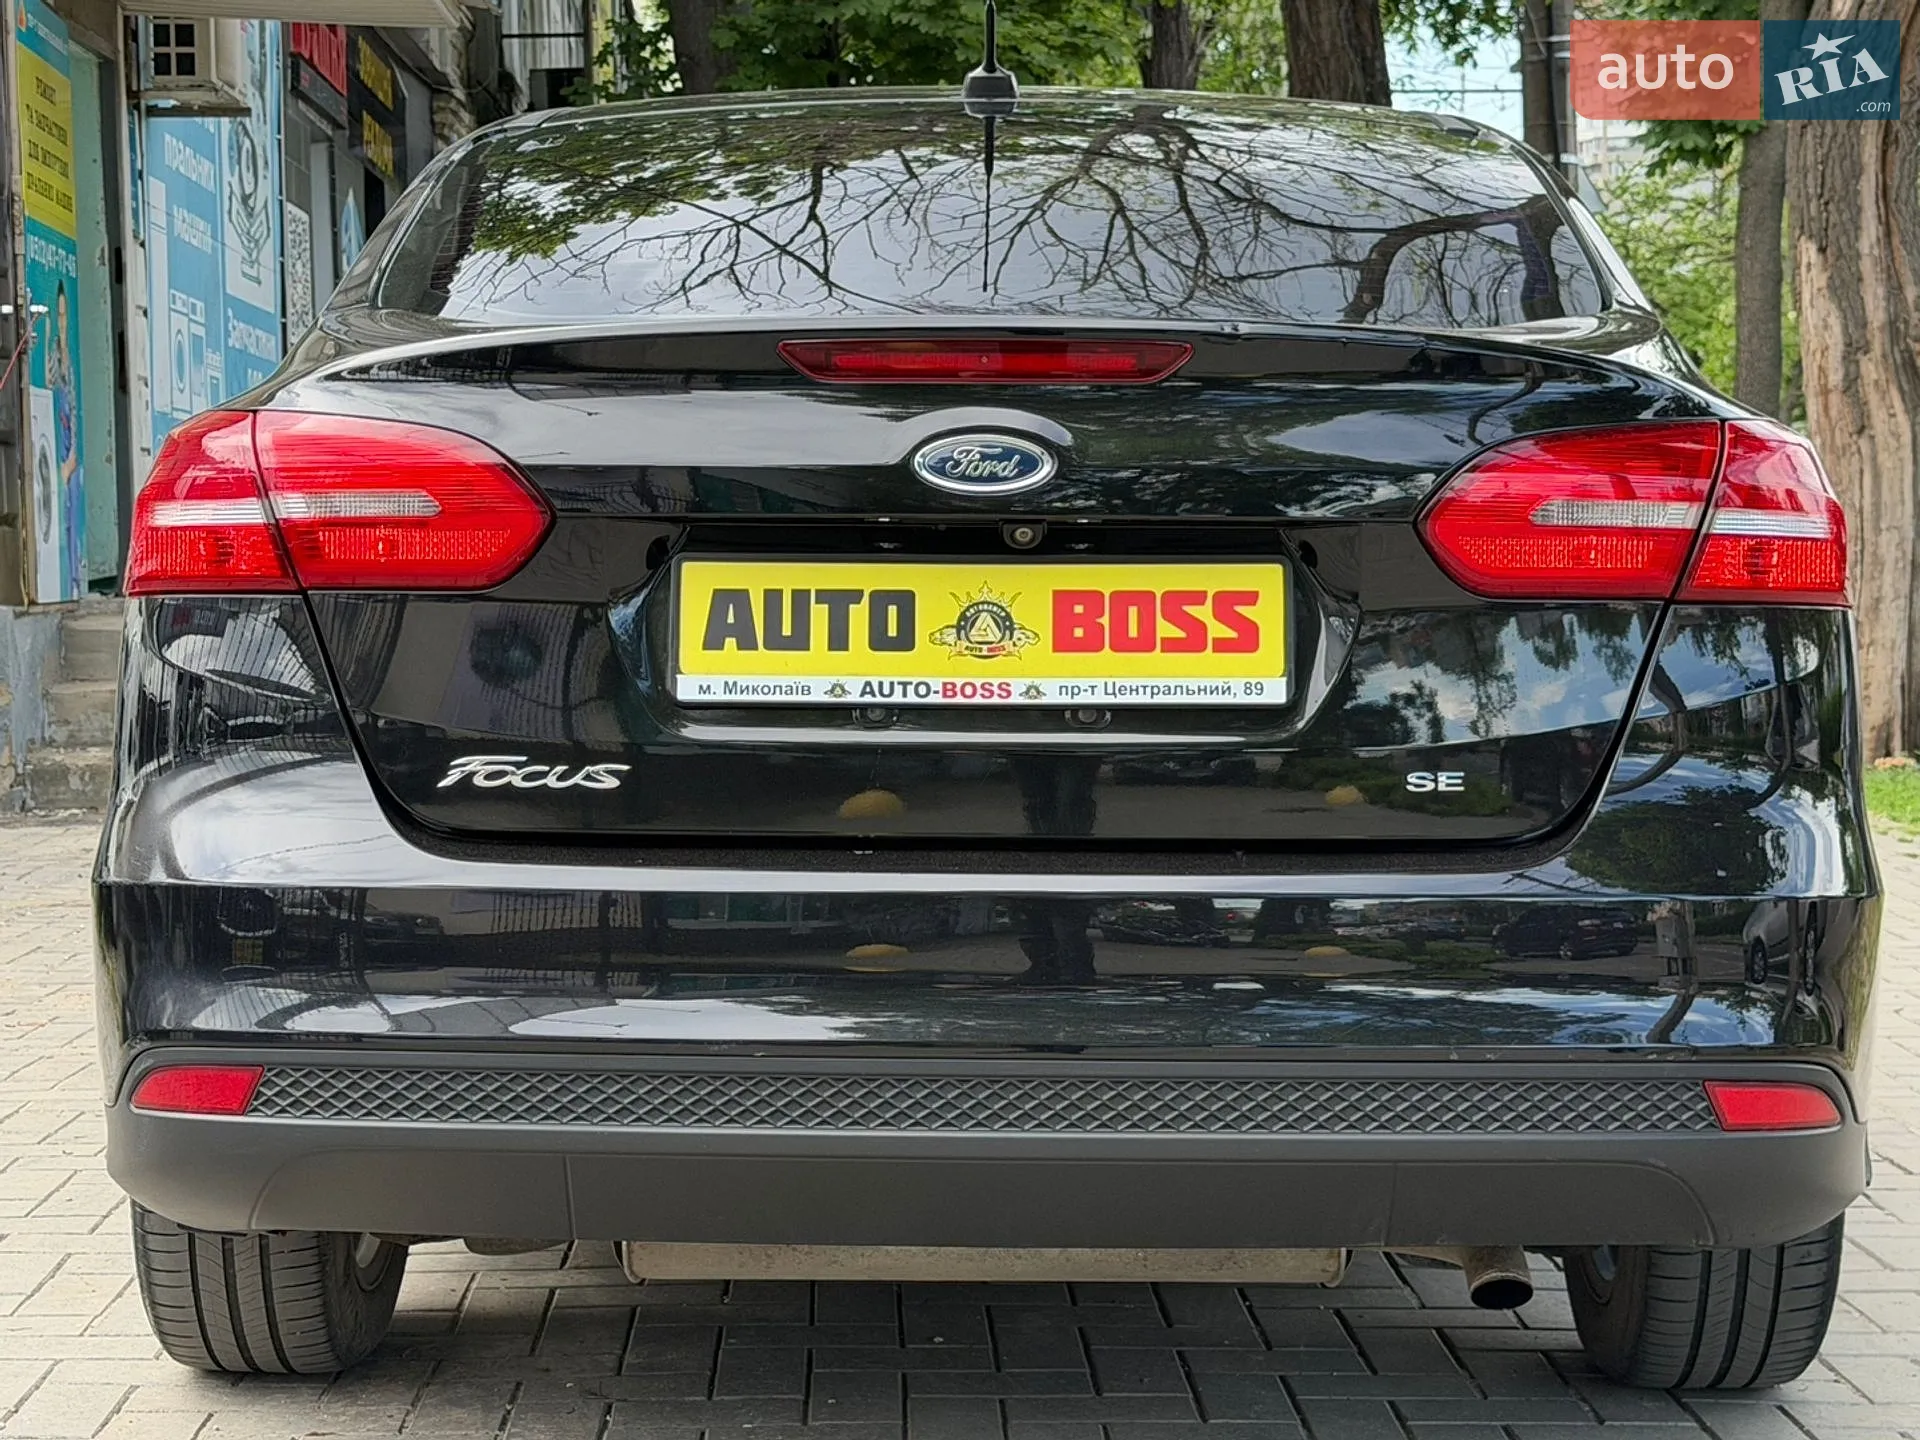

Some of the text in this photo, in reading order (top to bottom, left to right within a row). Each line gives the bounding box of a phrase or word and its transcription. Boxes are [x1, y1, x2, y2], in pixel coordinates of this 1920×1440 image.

[945, 446, 1021, 478] Ford
[702, 588, 1260, 653] AUTO BOSS
[698, 680, 1265, 699] м. Миколаїв AUTO-BOSS пр-т Центральний, 89
[1405, 771, 1465, 792] SE
